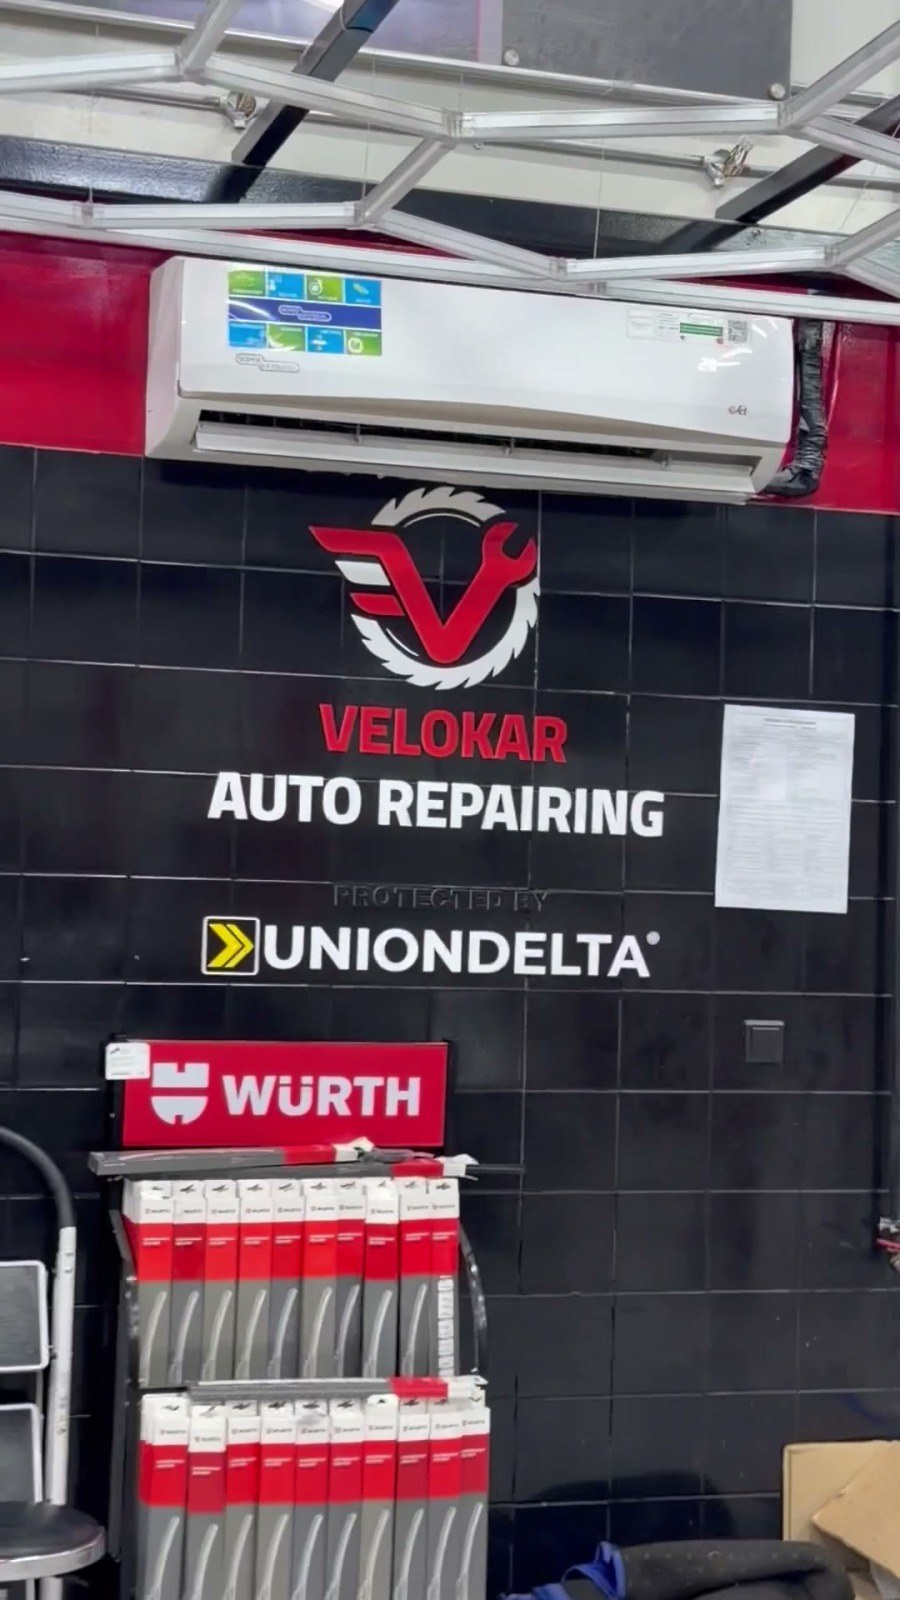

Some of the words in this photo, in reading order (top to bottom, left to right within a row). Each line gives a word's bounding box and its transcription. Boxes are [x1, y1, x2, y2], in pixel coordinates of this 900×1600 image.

[319, 703, 567, 764] VELOKAR
[207, 771, 362, 825] AUTO
[377, 779, 665, 837] REPAIRING
[333, 885, 502, 910] PROTECTED
[513, 890, 549, 912] BY
[263, 924, 651, 978] UNIONDELTA
[222, 1075, 421, 1116] WÜRTH
